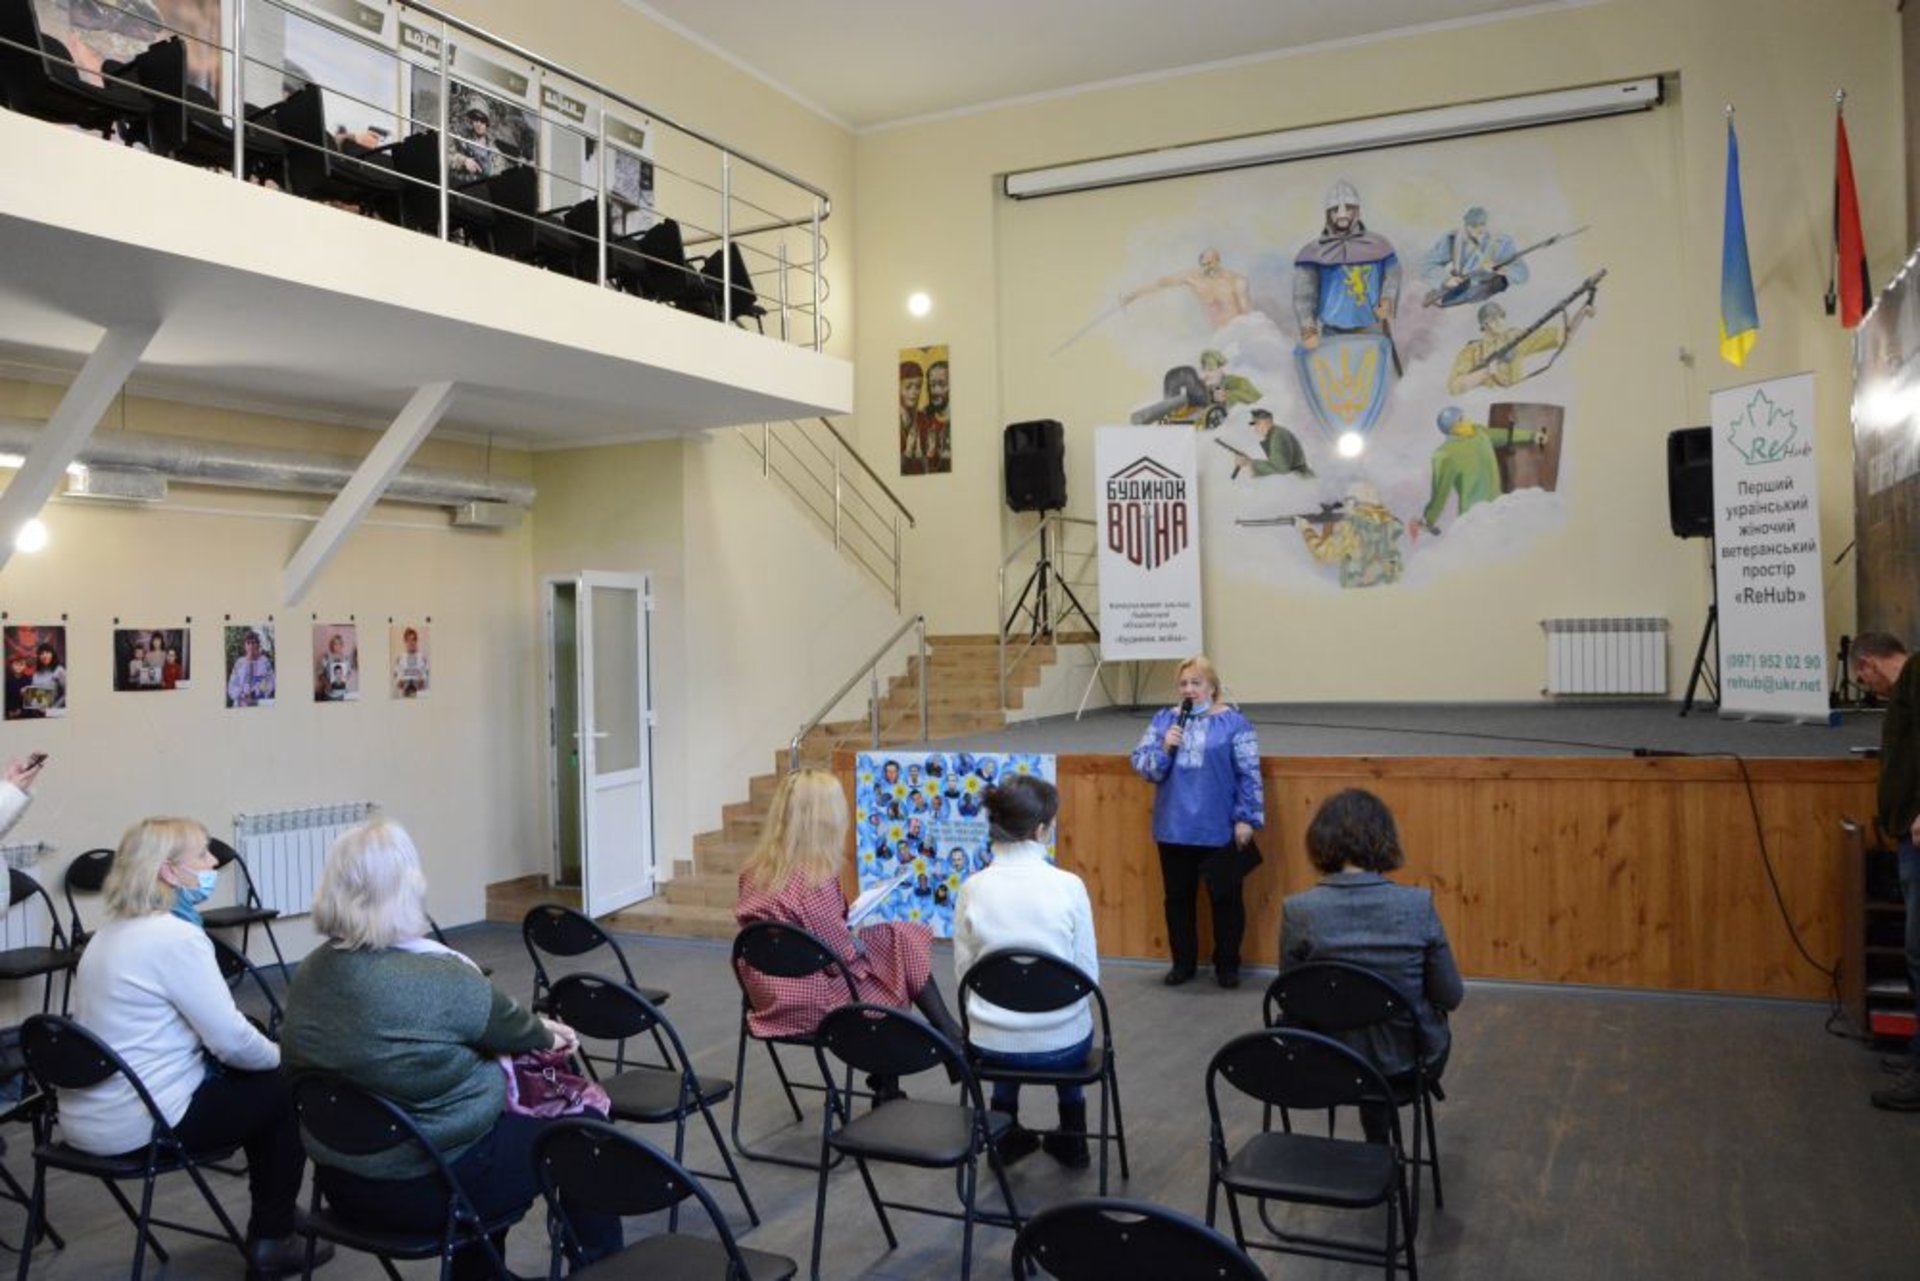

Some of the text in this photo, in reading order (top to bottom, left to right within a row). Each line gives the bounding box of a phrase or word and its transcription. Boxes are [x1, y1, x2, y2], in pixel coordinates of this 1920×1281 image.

[1107, 480, 1187, 500] БУДИНОК
[1737, 476, 1794, 498] Перший
[1725, 494, 1809, 521] український
[1107, 501, 1188, 571] ВОЇНА
[1738, 518, 1796, 536] жіночий
[1721, 537, 1817, 560] ветеранський
[1742, 561, 1796, 580] простір
[1735, 586, 1806, 604] «ReHub»
[1759, 654, 1782, 669] 952
[1785, 654, 1800, 669] 02
[1726, 675, 1822, 695] rehub@ukr.net
